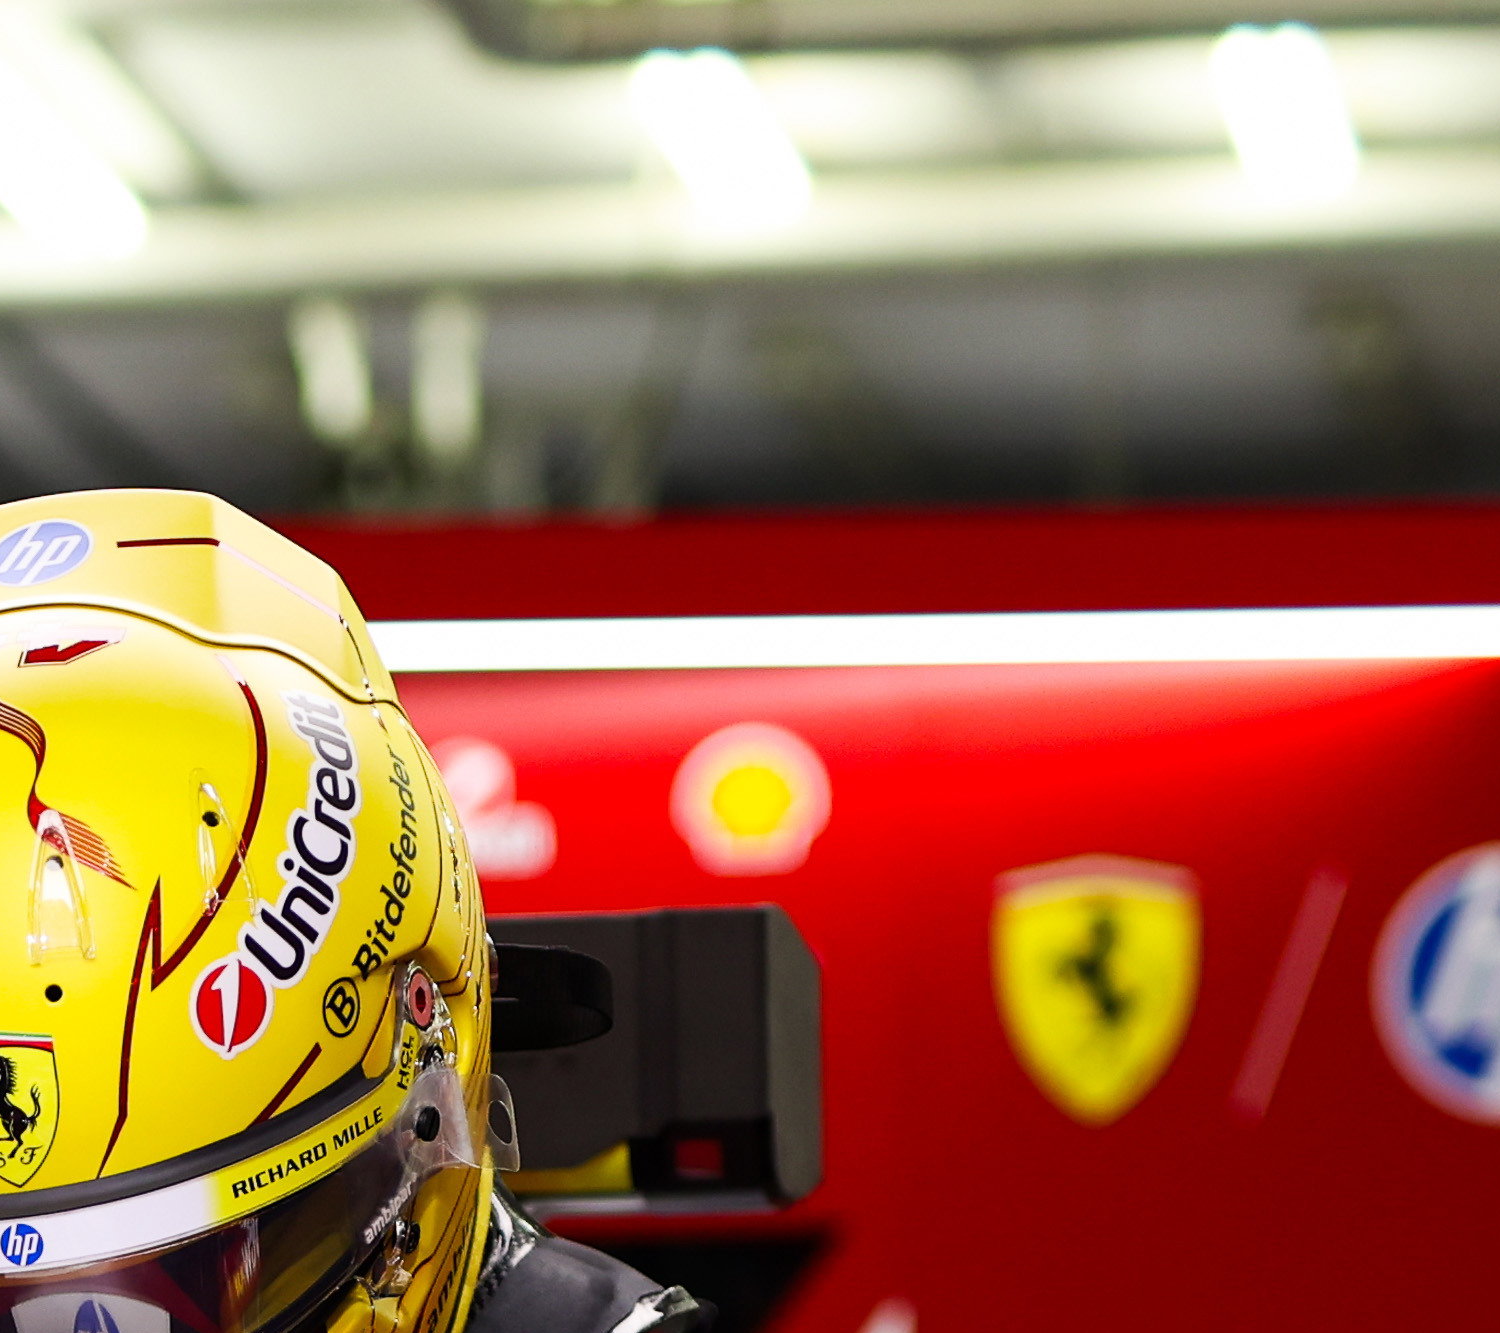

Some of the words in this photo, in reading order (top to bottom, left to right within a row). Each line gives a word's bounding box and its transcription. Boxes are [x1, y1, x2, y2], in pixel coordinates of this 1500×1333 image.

[244, 694, 357, 980] UniCredit
[351, 742, 419, 982] Bitdefender
[231, 1142, 328, 1199] RICHARD
[332, 1106, 383, 1151] MILLE
[4, 1223, 41, 1267] hp
